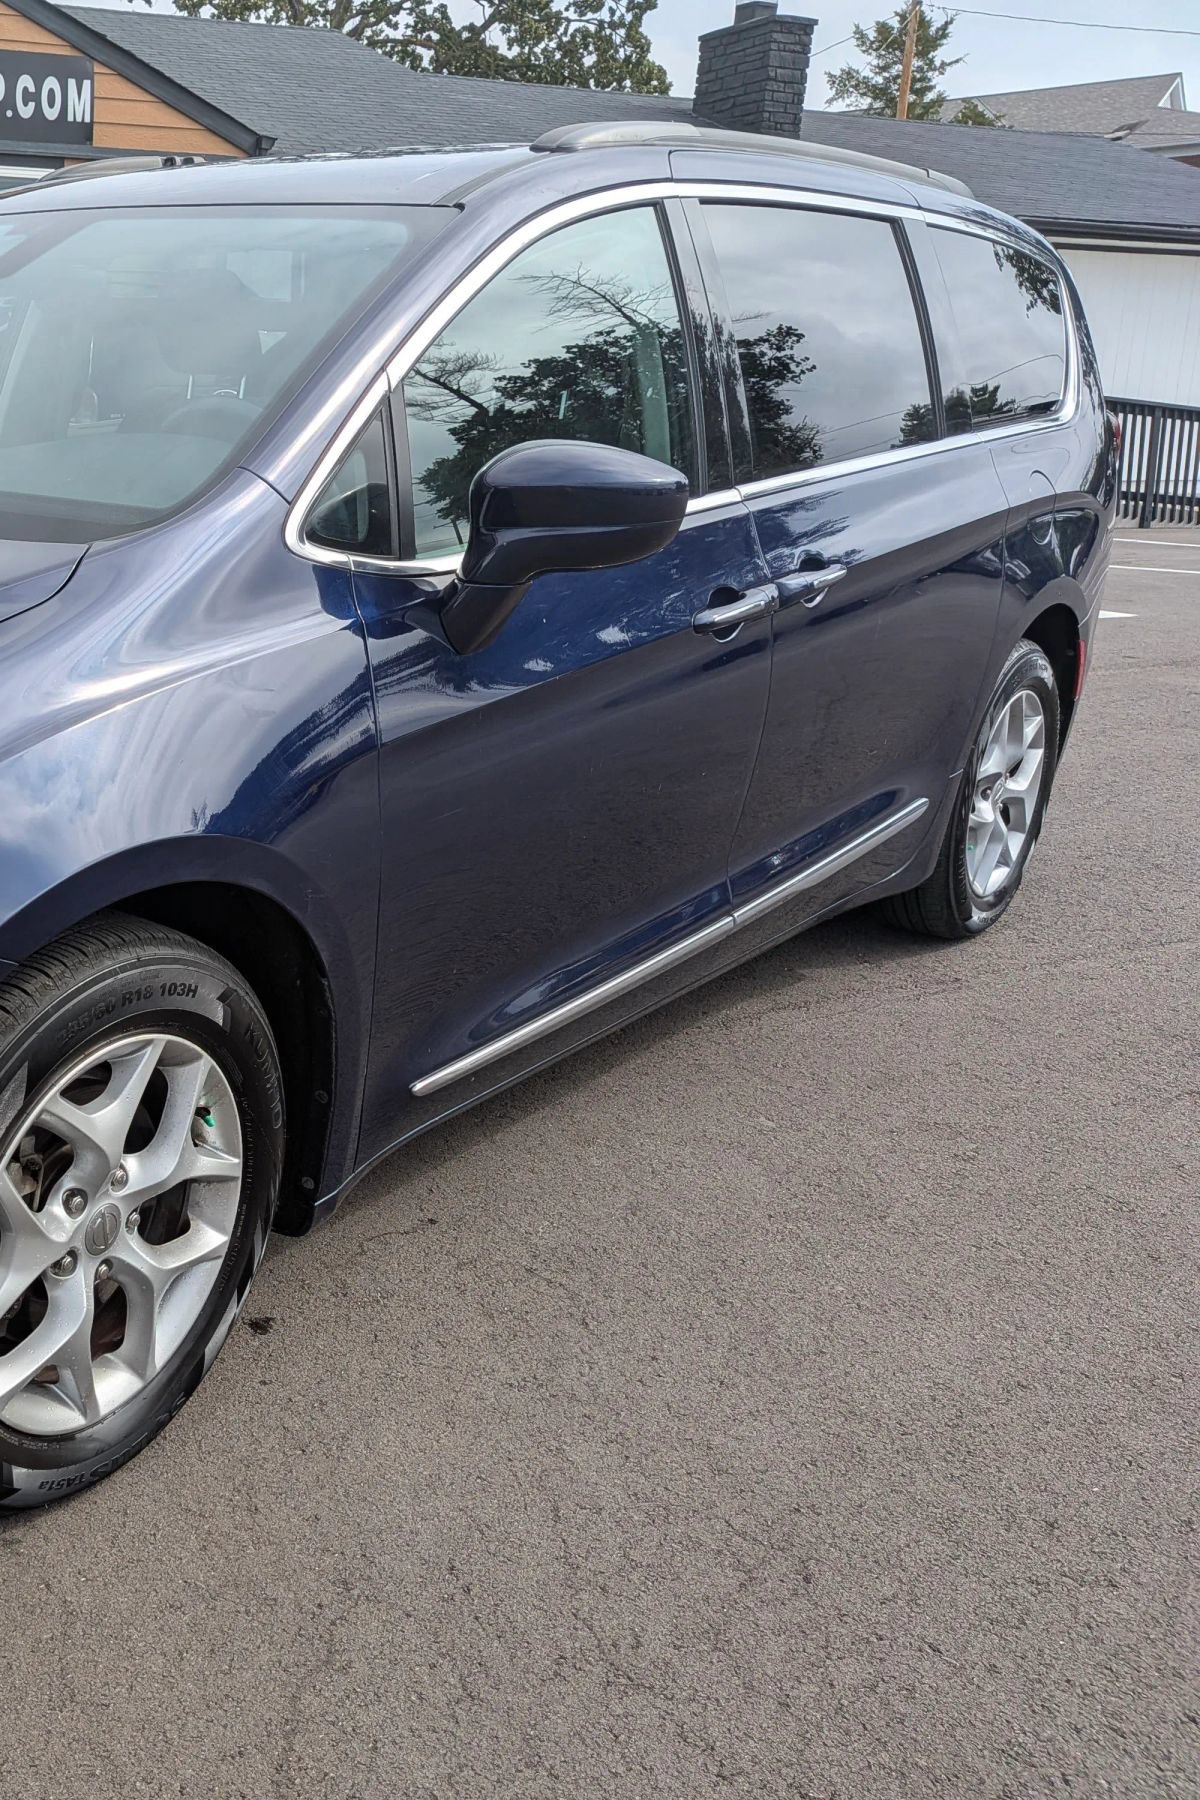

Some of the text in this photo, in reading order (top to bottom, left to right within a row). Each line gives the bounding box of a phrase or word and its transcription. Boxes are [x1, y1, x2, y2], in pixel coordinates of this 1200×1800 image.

[121, 985, 154, 1008] R18
[159, 982, 199, 999] 103H
[38, 1472, 86, 1493] TA51a
